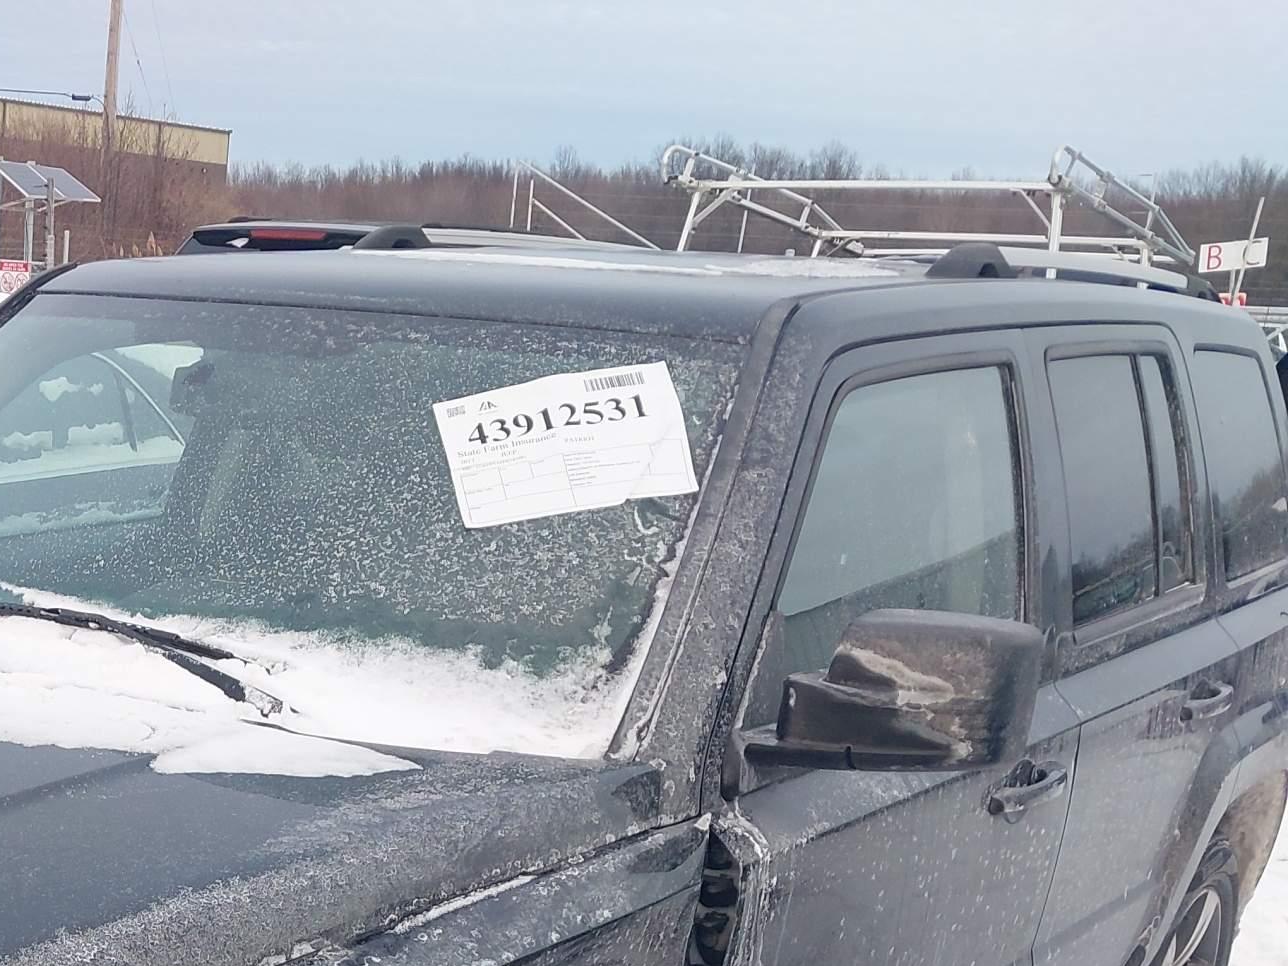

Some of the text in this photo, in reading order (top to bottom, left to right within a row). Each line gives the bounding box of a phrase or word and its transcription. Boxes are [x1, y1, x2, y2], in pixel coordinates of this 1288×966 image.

[1207, 244, 1223, 271] B
[468, 393, 649, 445] 43912531
[457, 432, 557, 458] State Farm Insurance
